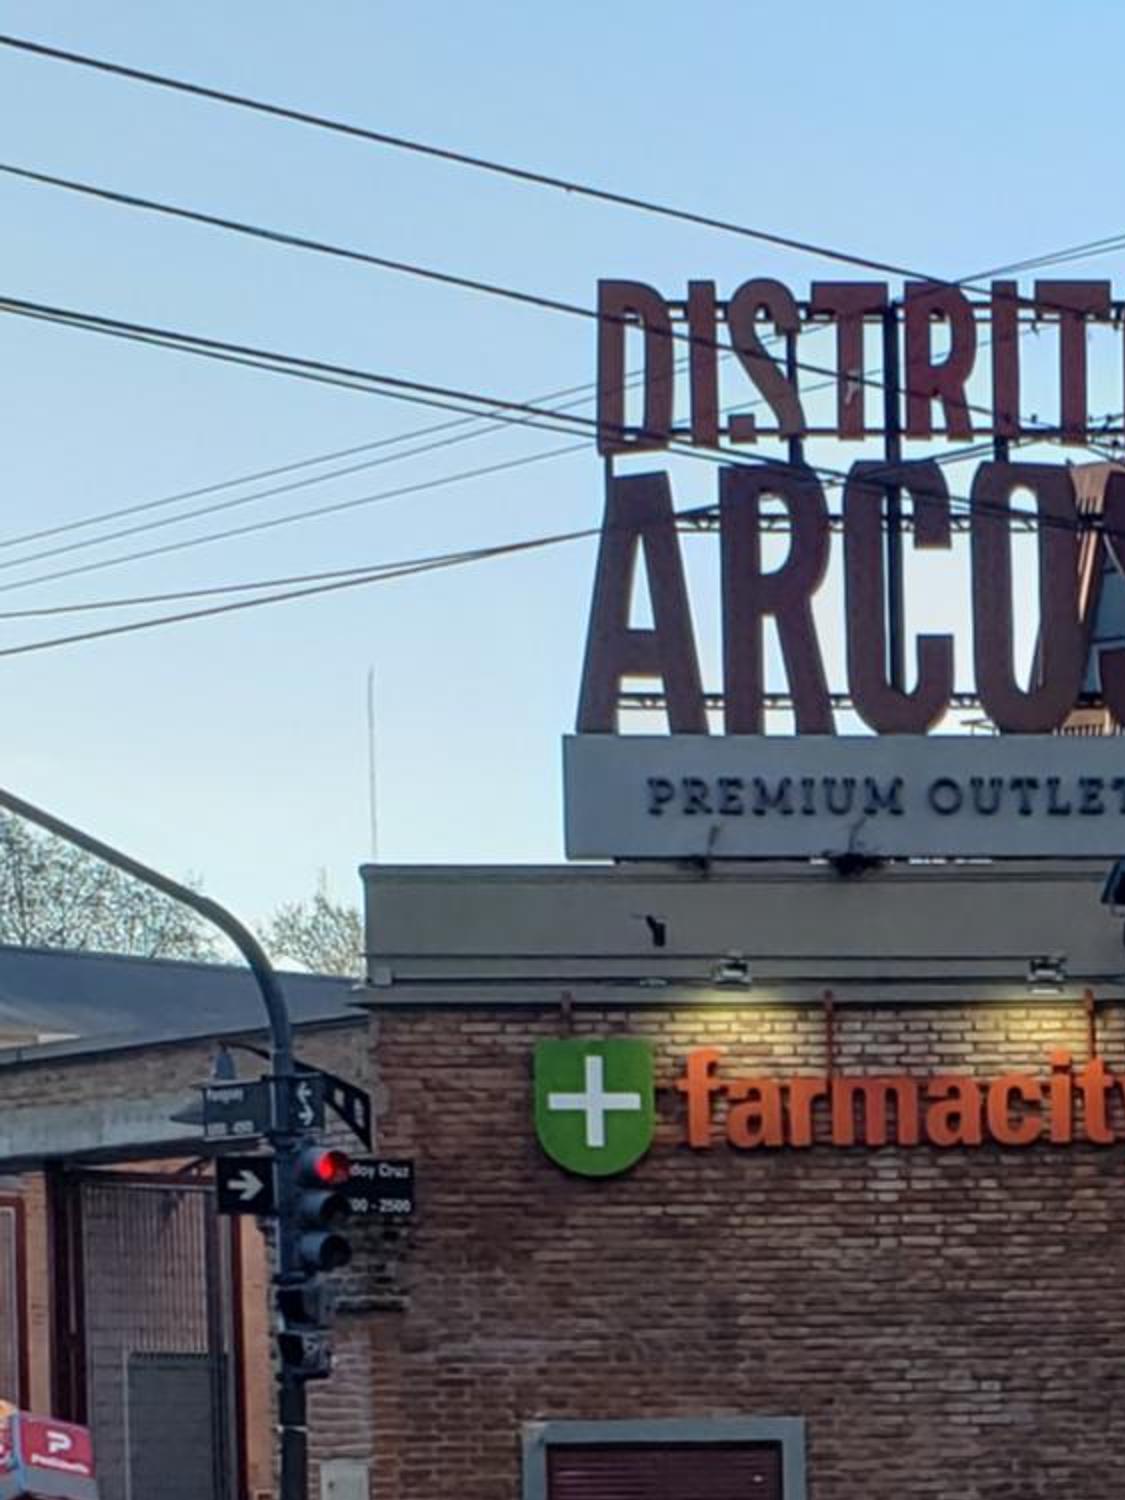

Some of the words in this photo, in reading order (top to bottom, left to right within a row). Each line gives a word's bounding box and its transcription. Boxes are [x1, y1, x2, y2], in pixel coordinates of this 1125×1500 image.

[646, 776, 905, 817] PREMIUM
[378, 1162, 410, 1179] Cruz
[379, 1198, 412, 1213] 2500
